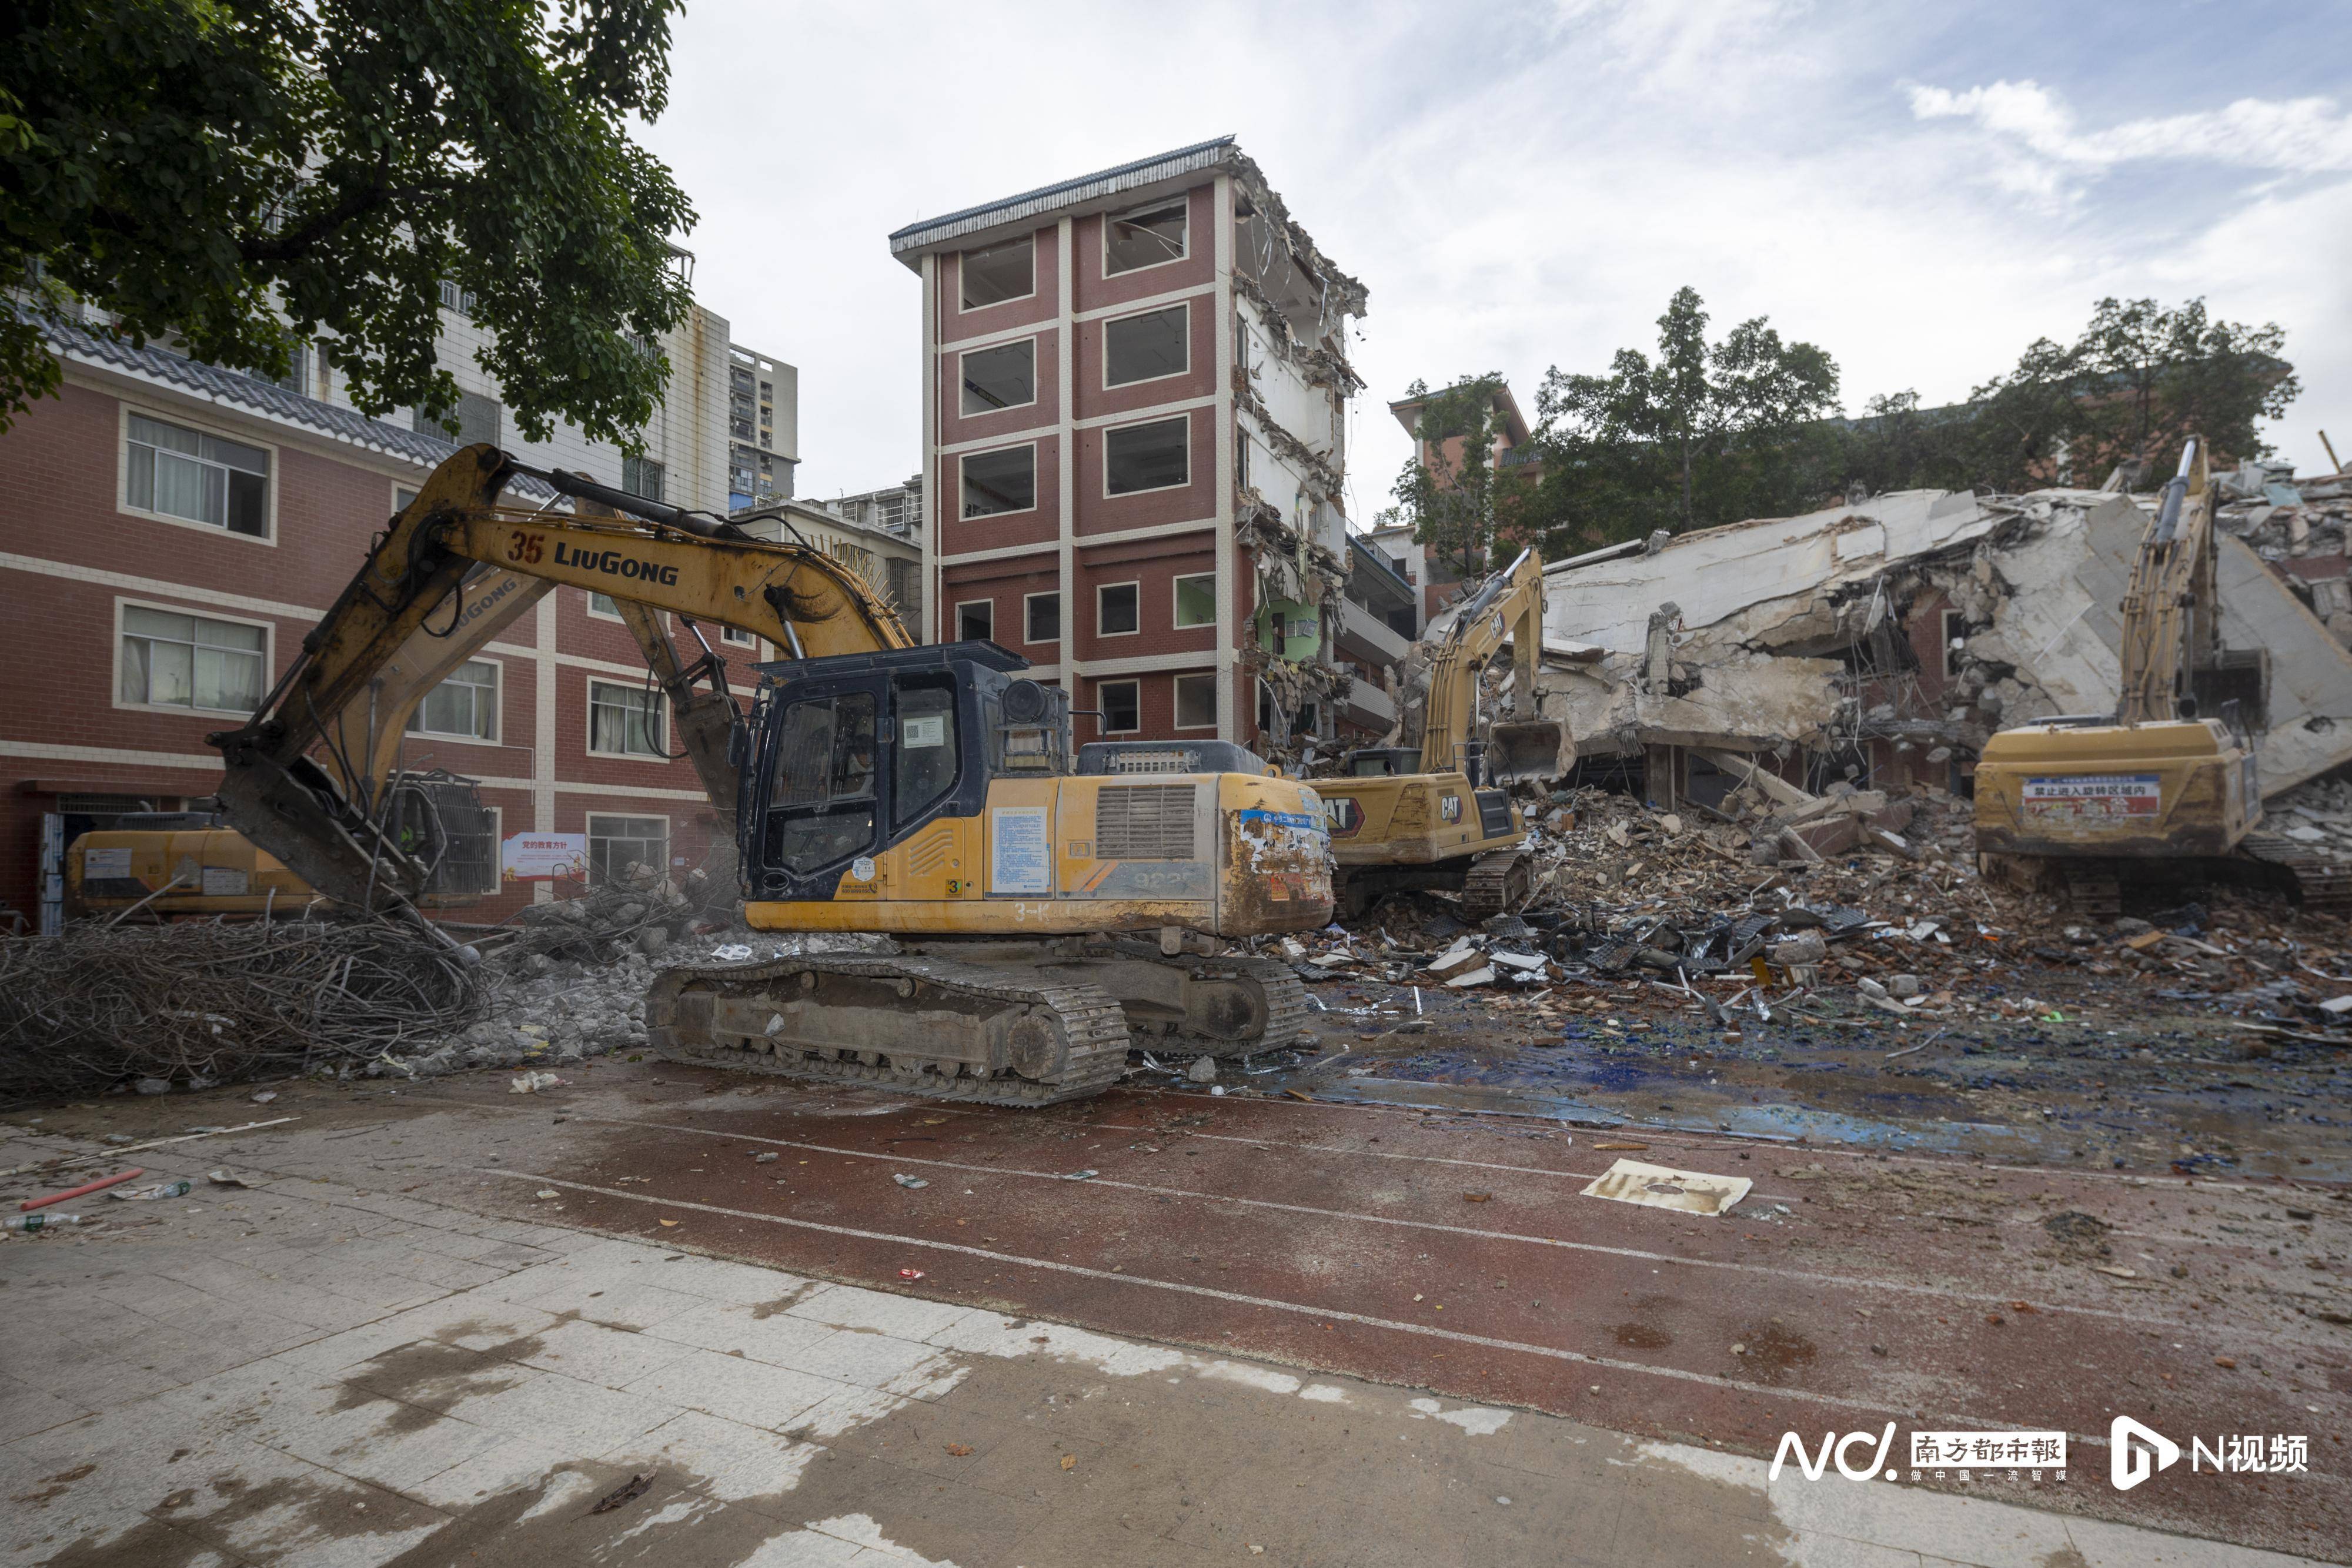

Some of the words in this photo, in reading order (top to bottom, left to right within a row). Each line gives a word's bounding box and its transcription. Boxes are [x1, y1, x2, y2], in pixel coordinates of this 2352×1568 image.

[507, 530, 546, 564] 35
[1490, 612, 1503, 640] CAT
[1324, 798, 1351, 829] AT
[1441, 796, 1459, 820] CAT
[522, 840, 568, 850] 党的教育方针
